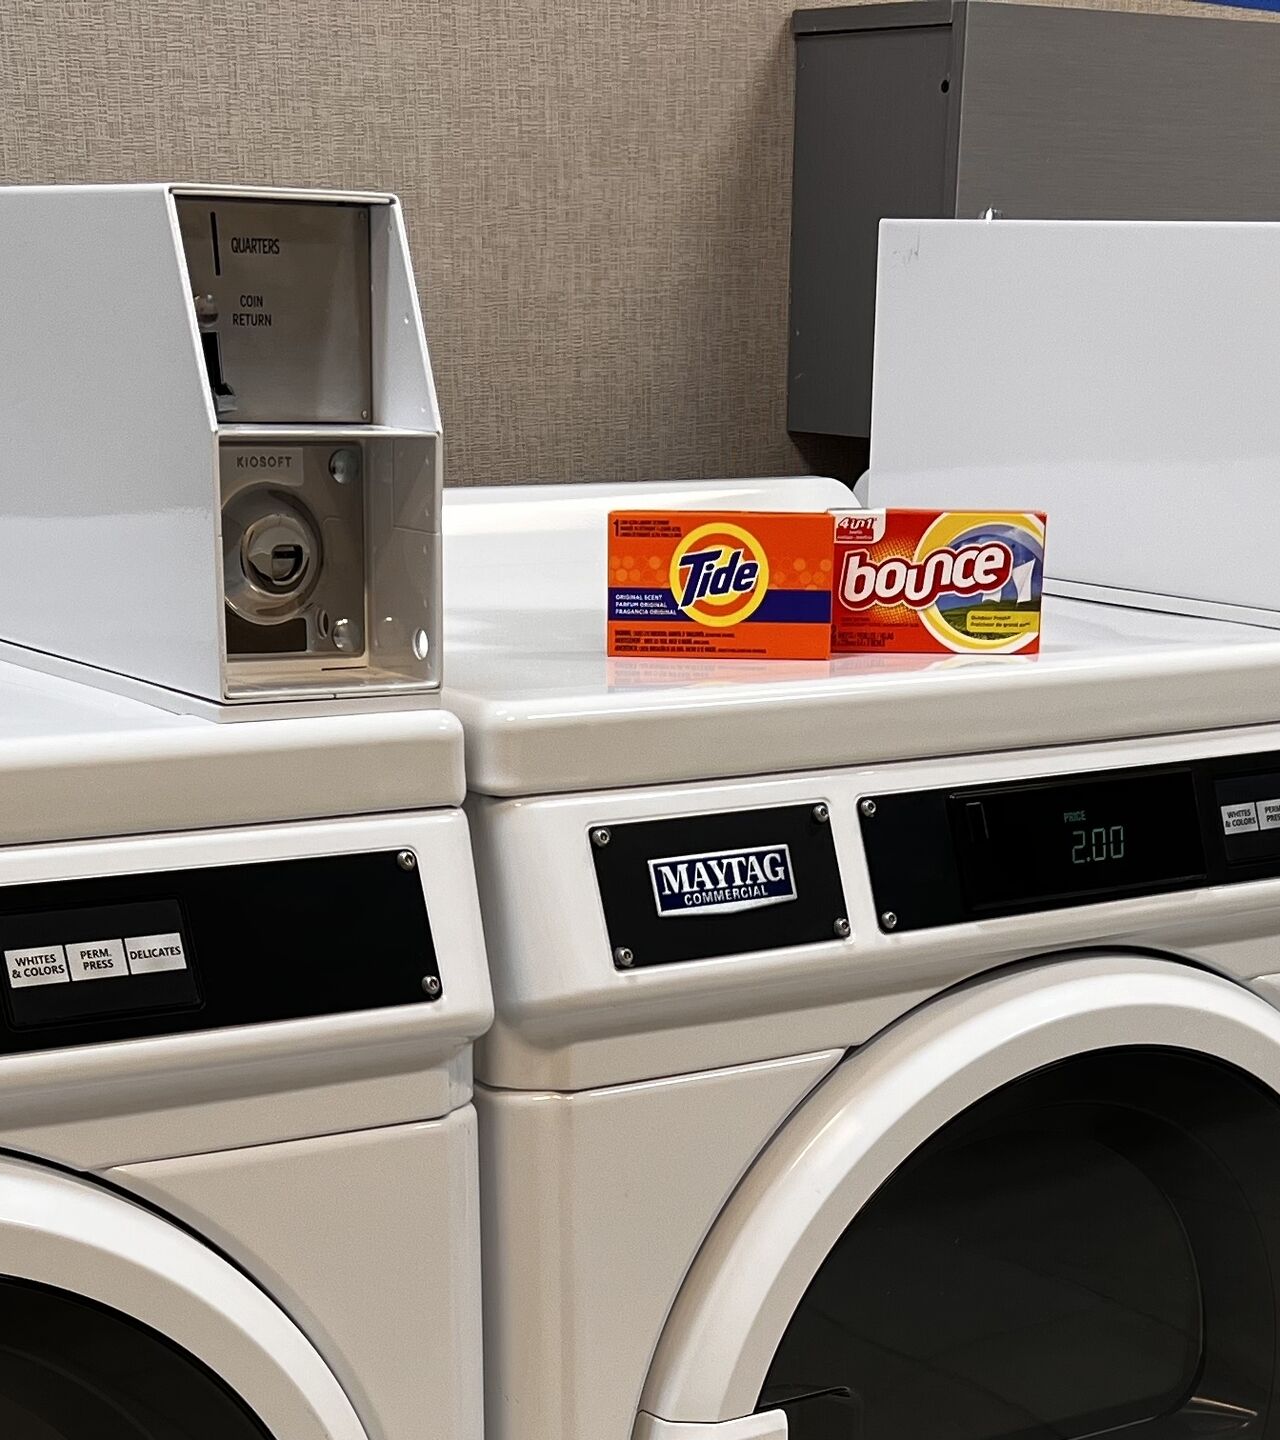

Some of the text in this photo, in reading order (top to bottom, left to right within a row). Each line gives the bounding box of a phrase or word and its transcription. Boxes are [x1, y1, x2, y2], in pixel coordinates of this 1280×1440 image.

[231, 237, 280, 254] QUARTERS
[239, 295, 264, 308] COIN
[232, 313, 272, 326] RETURN
[236, 455, 292, 468] KIOSOFT
[678, 548, 760, 609] Tide
[843, 545, 1006, 603] bounce
[1063, 810, 1087, 824] PRICE
[1226, 808, 1252, 819] WHITES
[1231, 817, 1257, 827] COLORS
[1071, 825, 1125, 864] 2.00
[657, 853, 786, 895] MAYTAG
[683, 884, 769, 906] COMMERCIAL
[14, 953, 57, 967] WHITES
[79, 948, 112, 960] PERM.
[129, 945, 182, 961] DELICATES
[11, 964, 65, 979] & COLORS
[82, 959, 114, 971] PRESS
